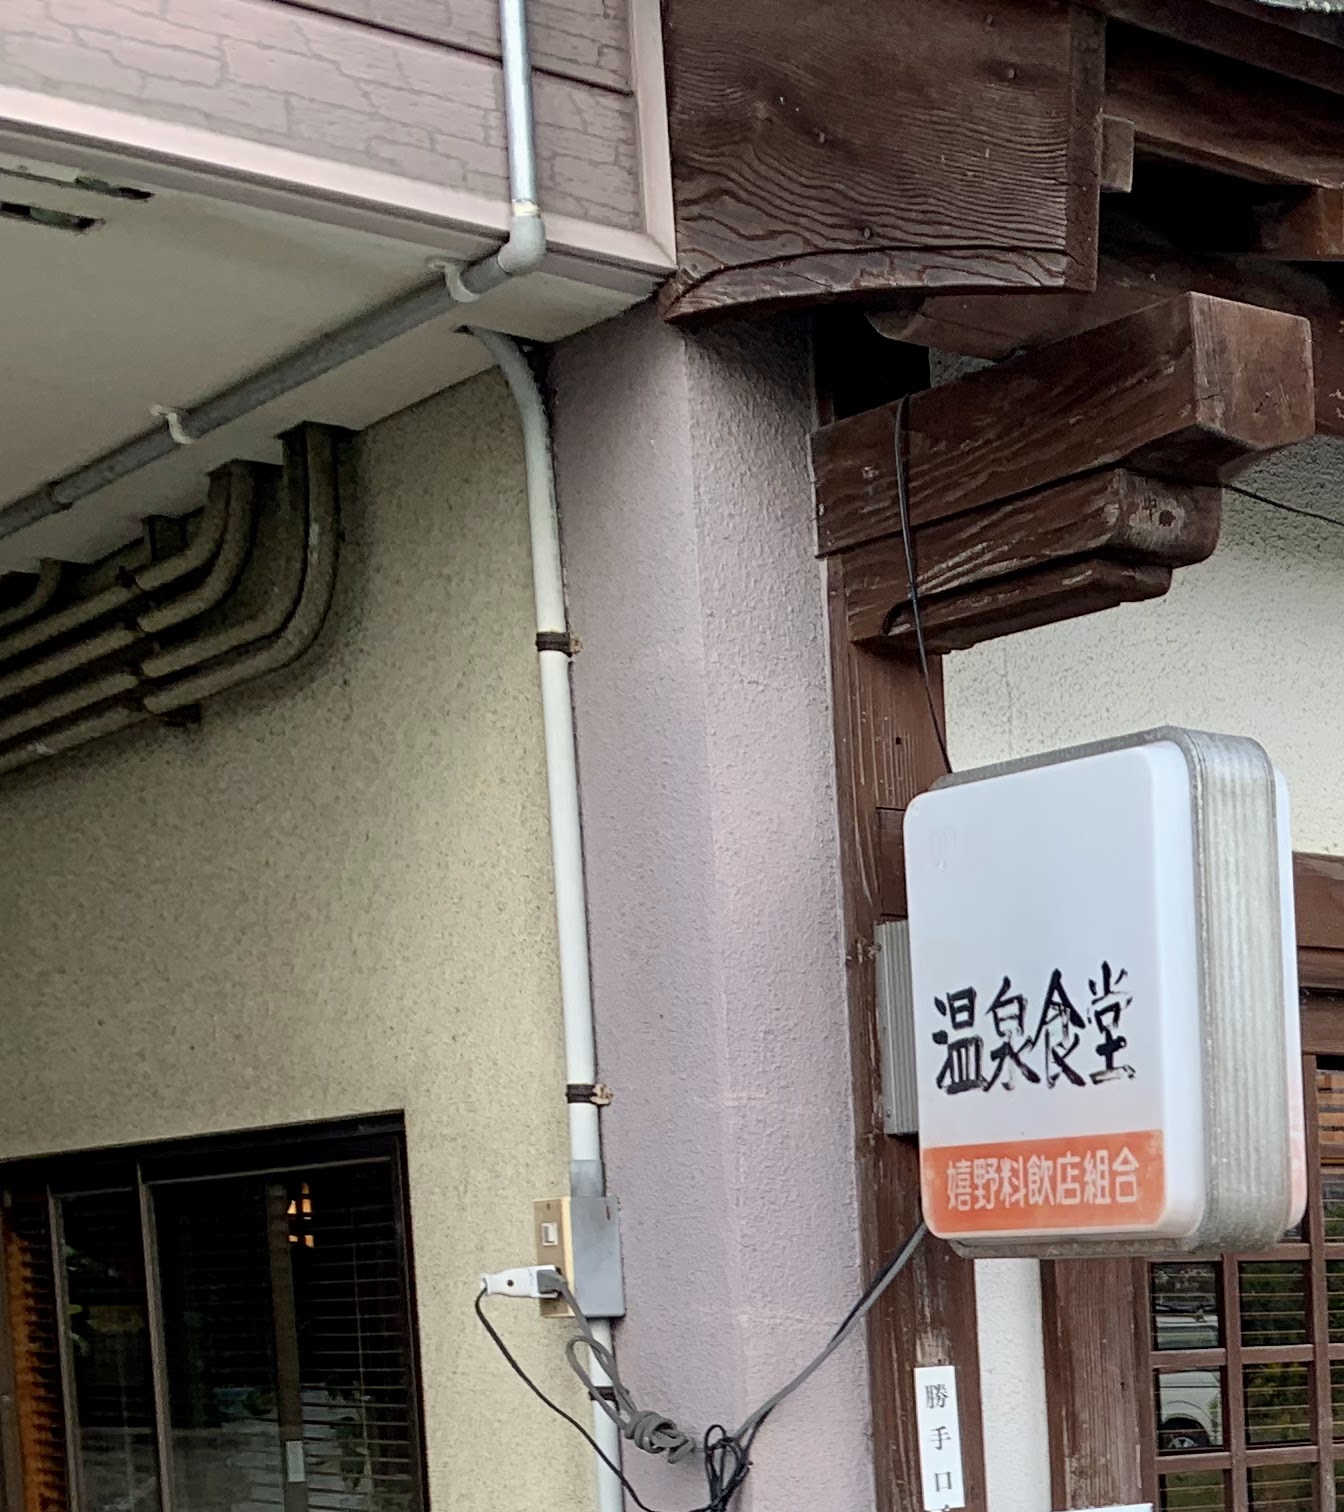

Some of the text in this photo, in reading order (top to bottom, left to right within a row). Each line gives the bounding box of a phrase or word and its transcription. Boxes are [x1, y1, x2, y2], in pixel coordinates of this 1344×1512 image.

[931, 960, 1136, 1095] 温泉食堂
[946, 1146, 1140, 1212] 嬉野料飲店組合
[924, 1383, 953, 1492] 勝手口
